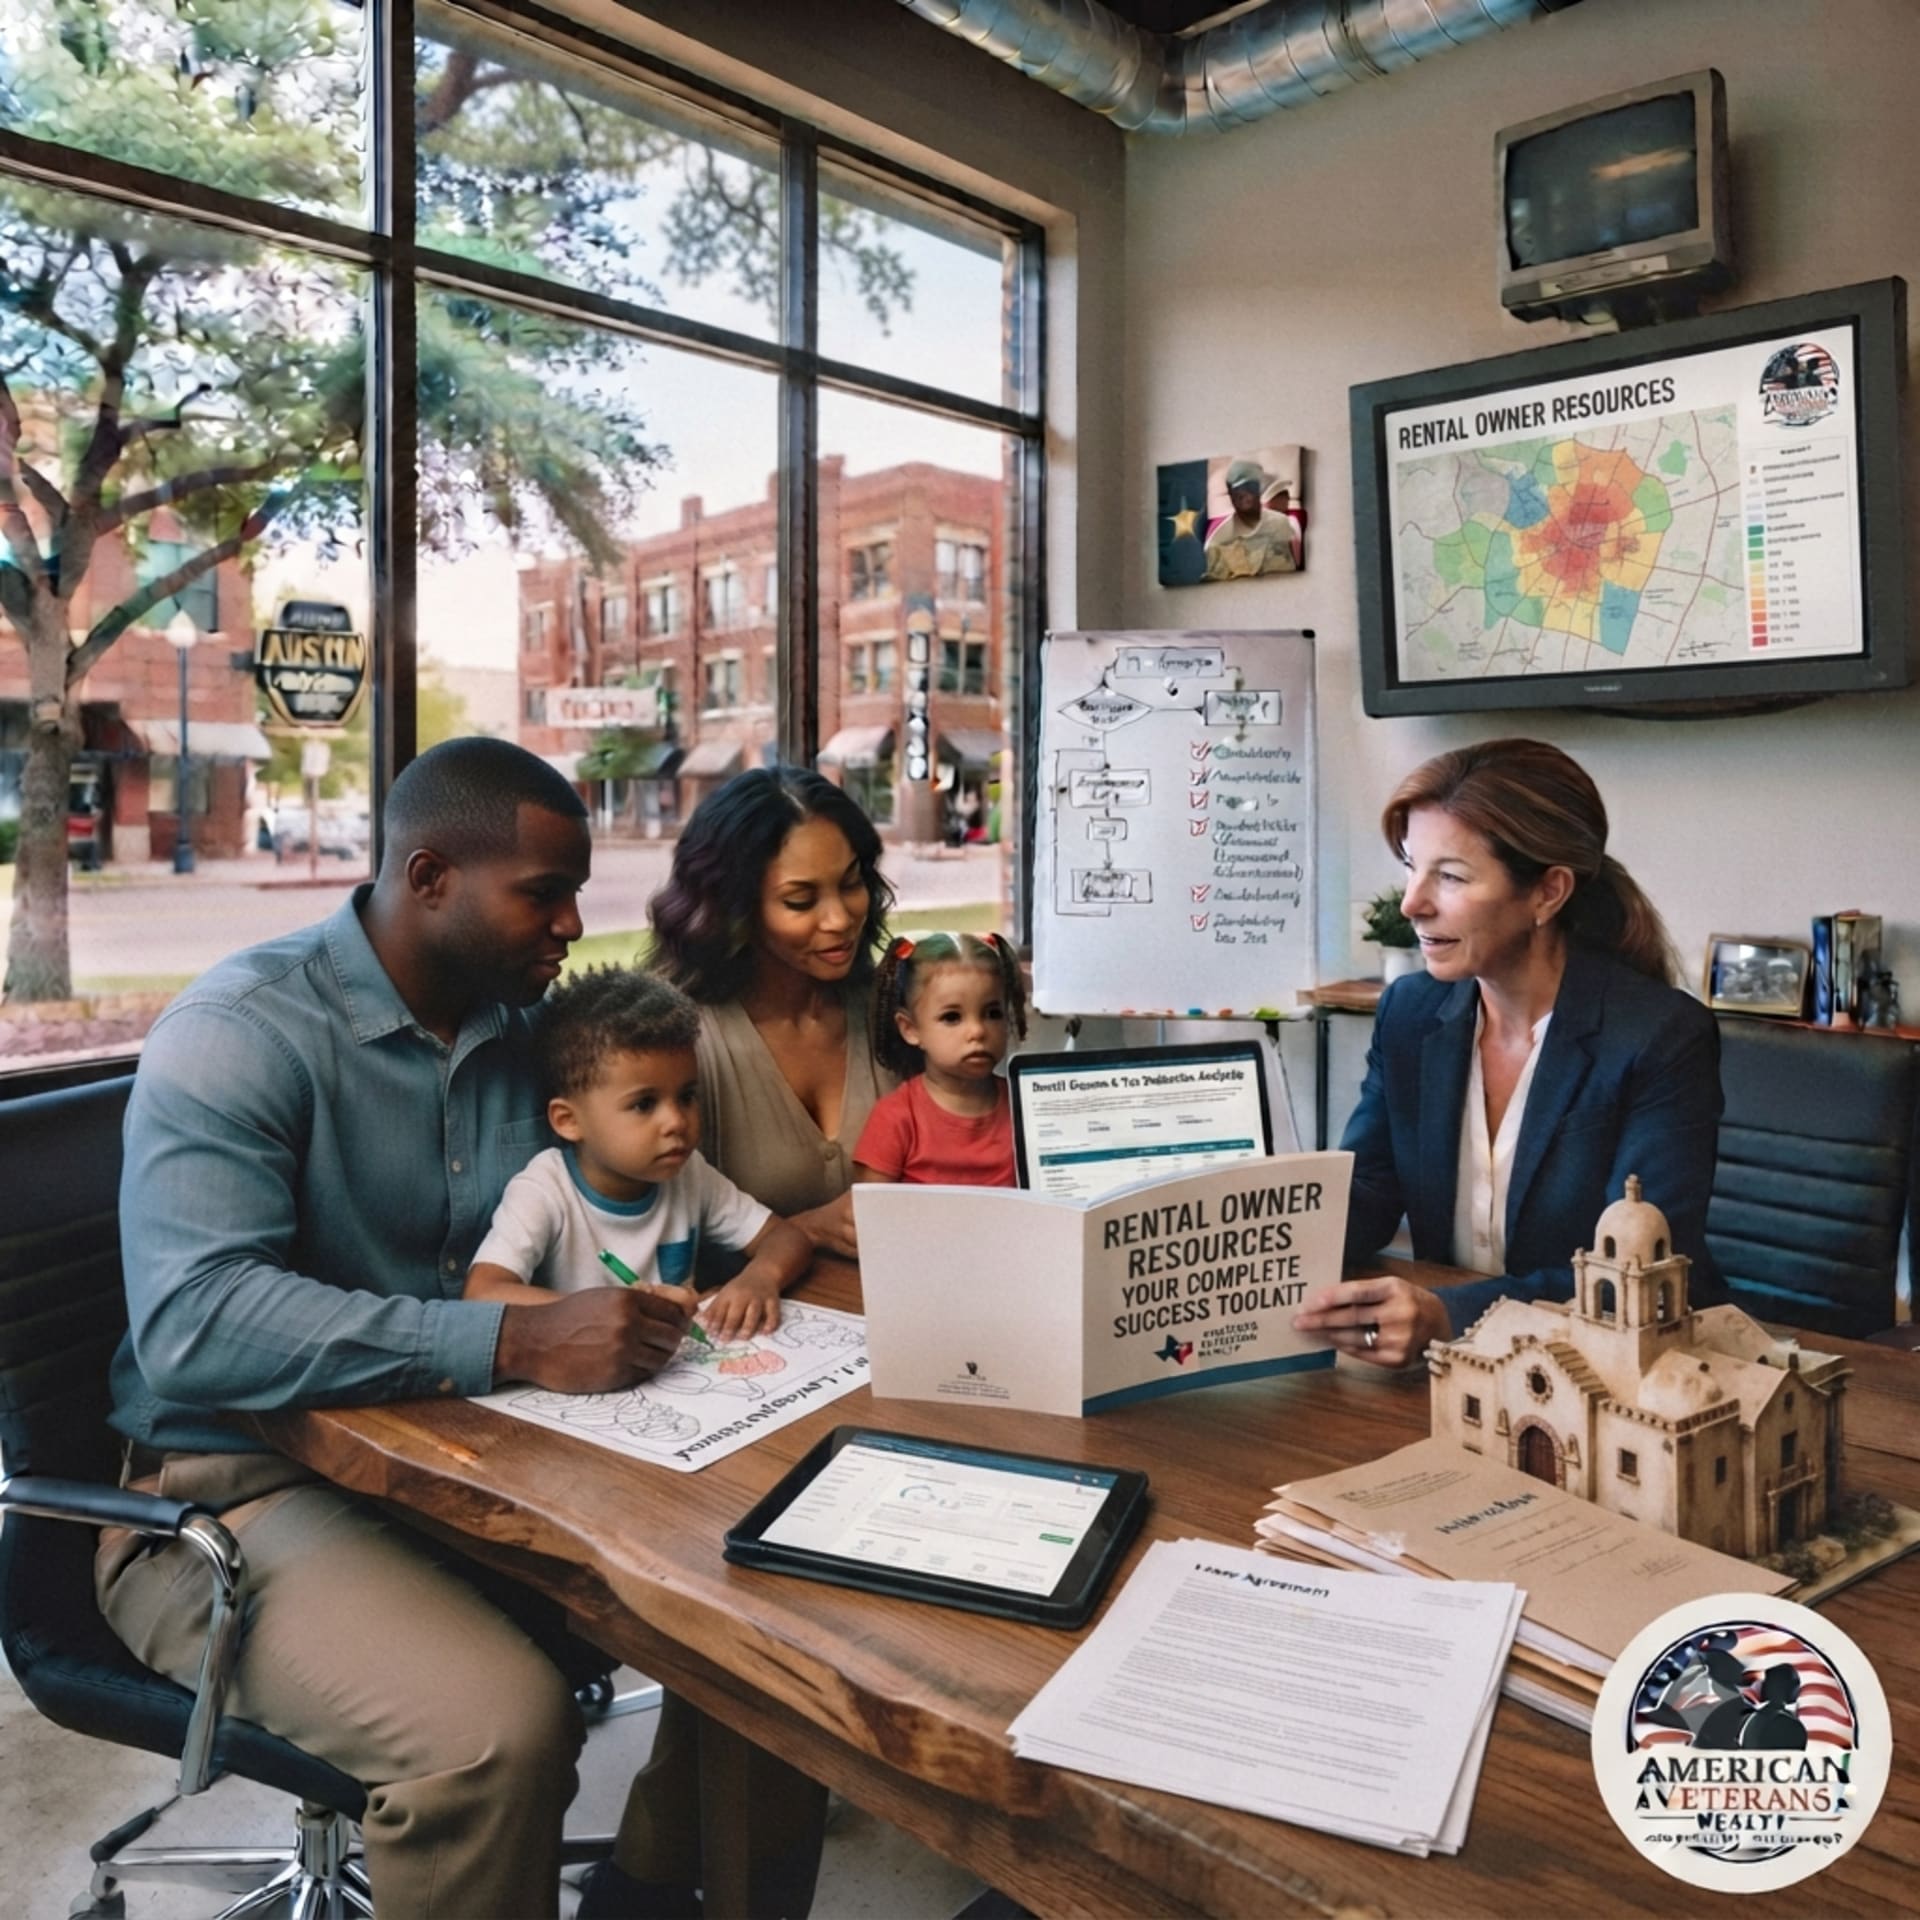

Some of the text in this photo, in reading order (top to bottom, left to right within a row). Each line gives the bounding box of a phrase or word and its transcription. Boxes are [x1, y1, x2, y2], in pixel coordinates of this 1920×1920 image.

[1398, 377, 1676, 450] RENTAL OWNER RESOURCES
[263, 631, 365, 669] AUSTIN
[1103, 1182, 1323, 1250] RENTAL OWNER
[1128, 1222, 1293, 1280] RESOURCES
[1122, 1255, 1301, 1309] YOUR COMPLETE
[1113, 1298, 1211, 1339] SUCCESS
